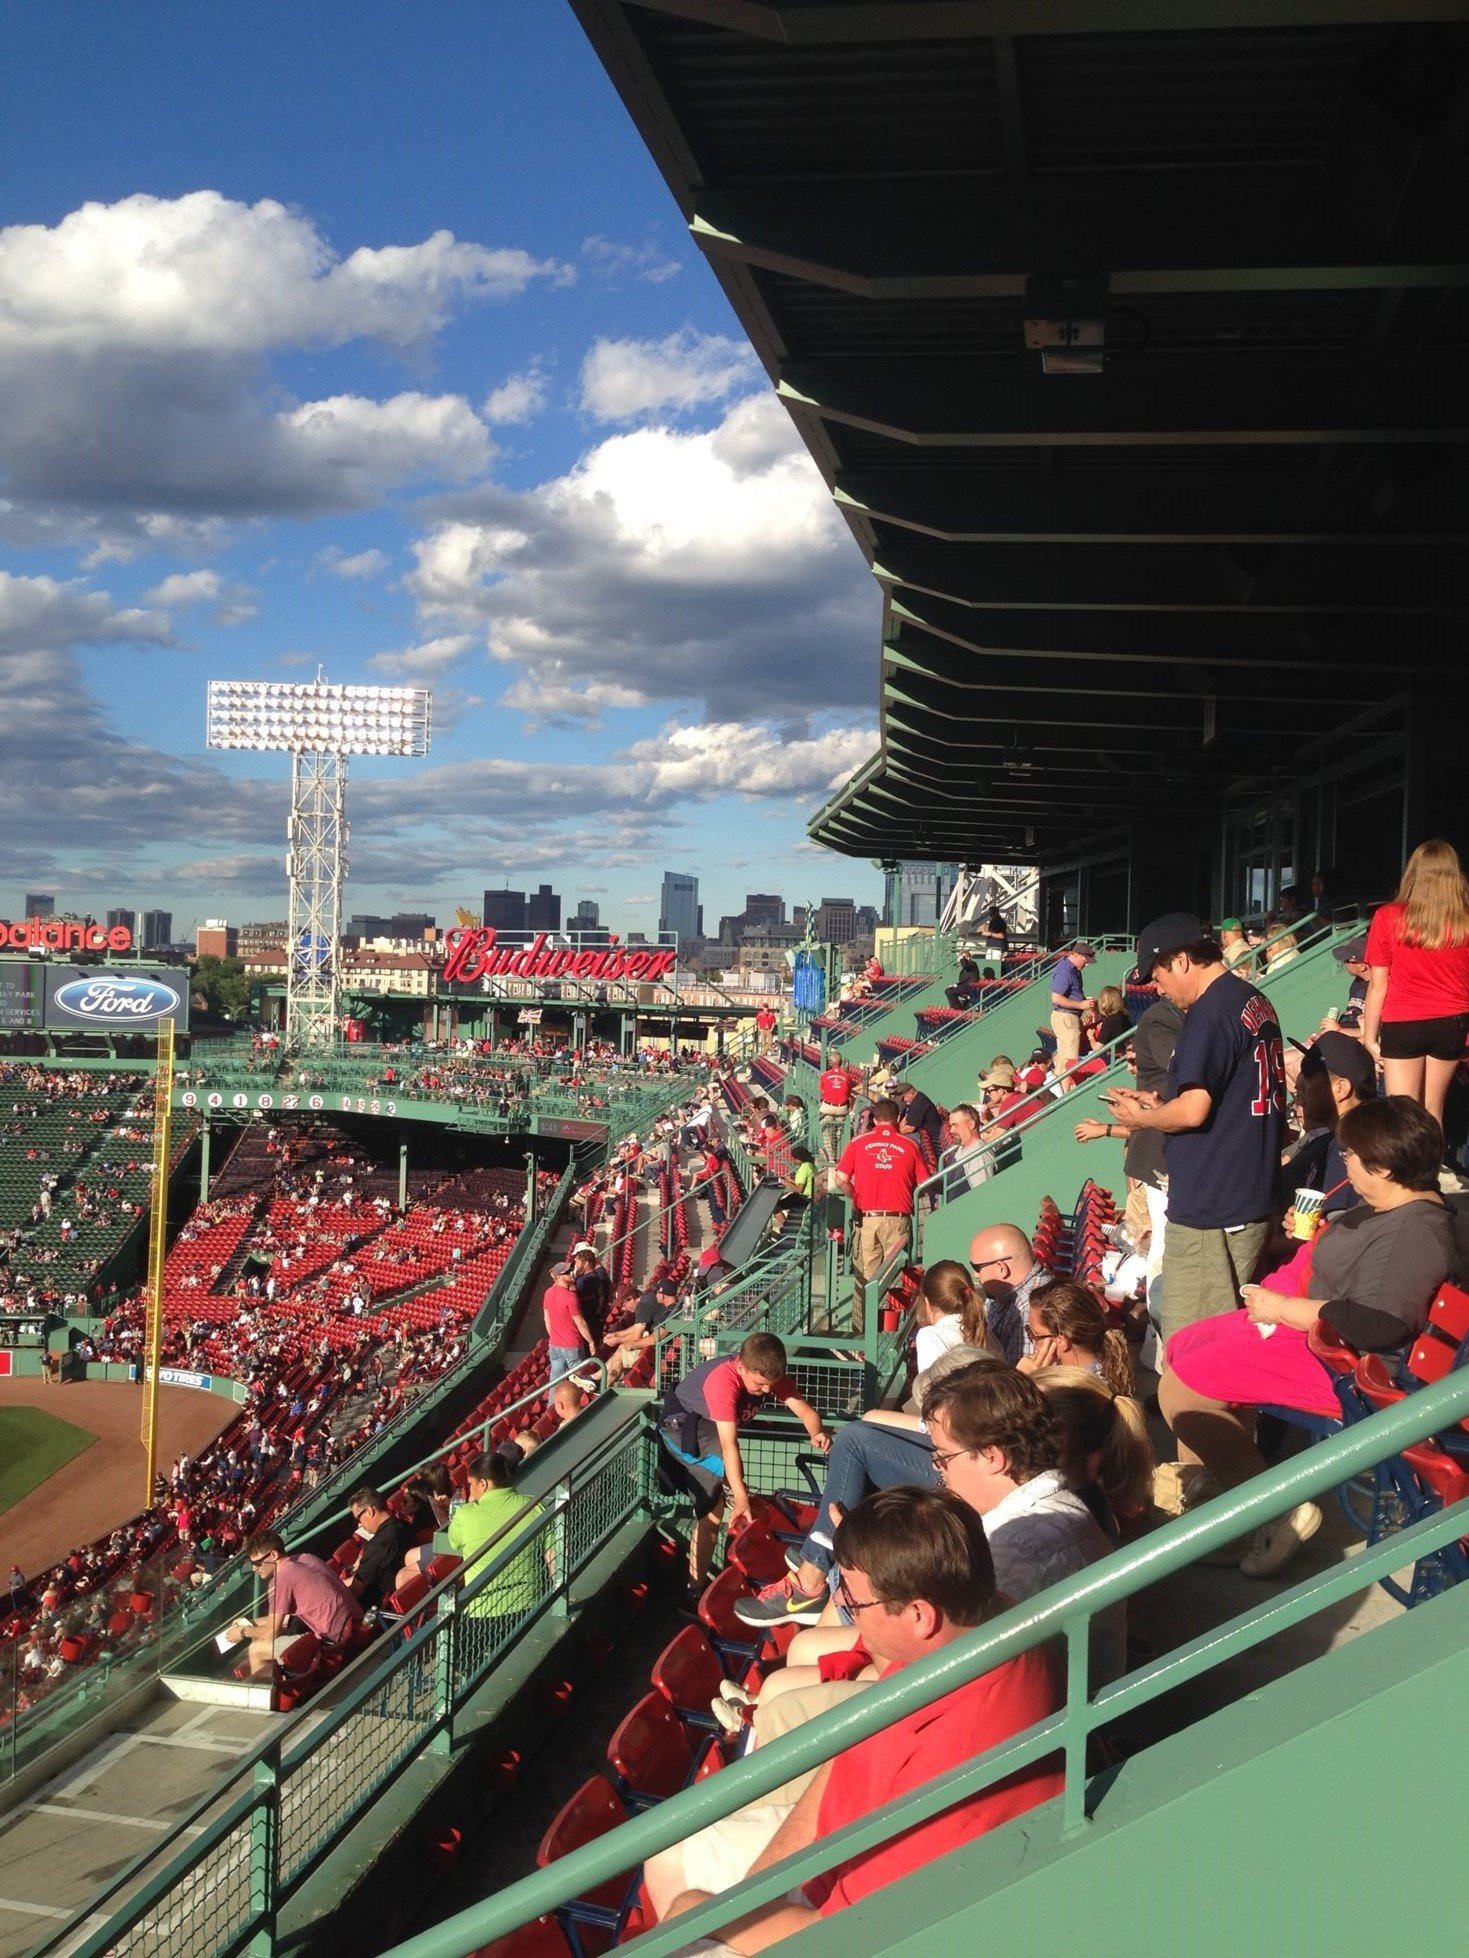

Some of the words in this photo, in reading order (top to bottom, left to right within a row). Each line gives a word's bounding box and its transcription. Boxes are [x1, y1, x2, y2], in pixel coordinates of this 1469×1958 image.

[443, 926, 678, 982] Budweiser
[15, 991, 35, 999] PARK
[80, 982, 154, 1014] Ford
[185, 1094, 194, 1105] 9
[211, 1095, 218, 1105] 4
[261, 1096, 270, 1107] 8
[282, 1097, 300, 1108] 27
[312, 1097, 321, 1108] 6
[386, 1104, 395, 1114] 42
[864, 1141, 890, 1151] FENWAY
[889, 1143, 906, 1154] PARK
[173, 1372, 203, 1386] TIRES
